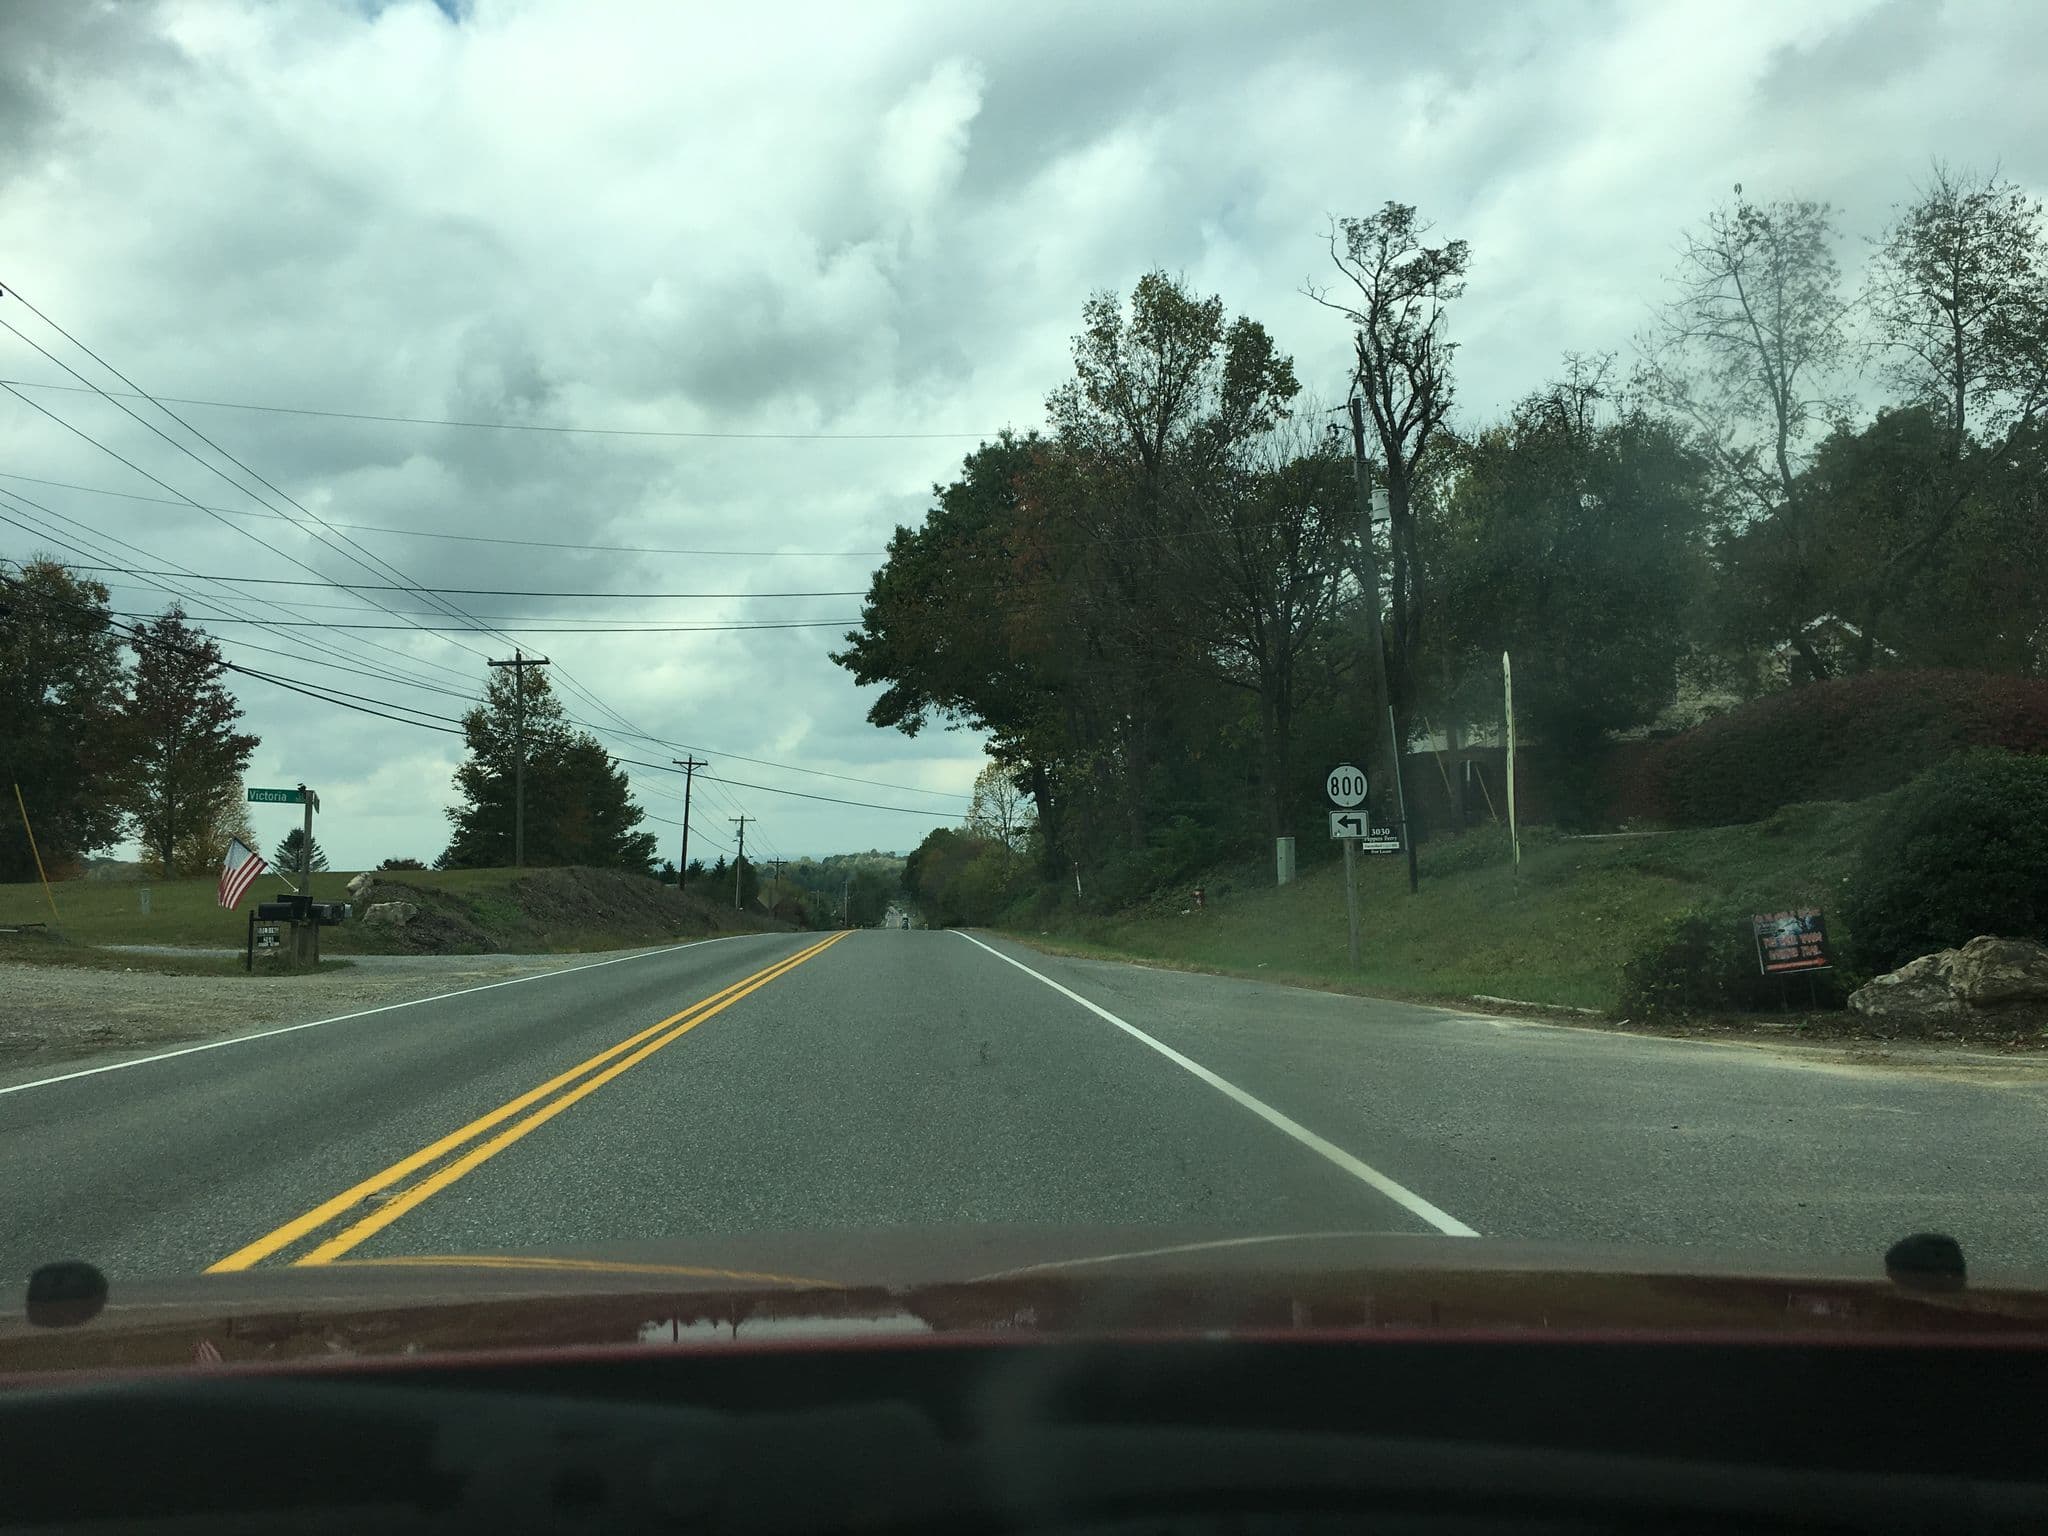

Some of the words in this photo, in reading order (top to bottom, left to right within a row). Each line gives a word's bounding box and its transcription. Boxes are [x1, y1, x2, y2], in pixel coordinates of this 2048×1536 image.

[1331, 776, 1363, 796] 800
[249, 790, 287, 801] Victoria
[1371, 828, 1390, 836] 3030
